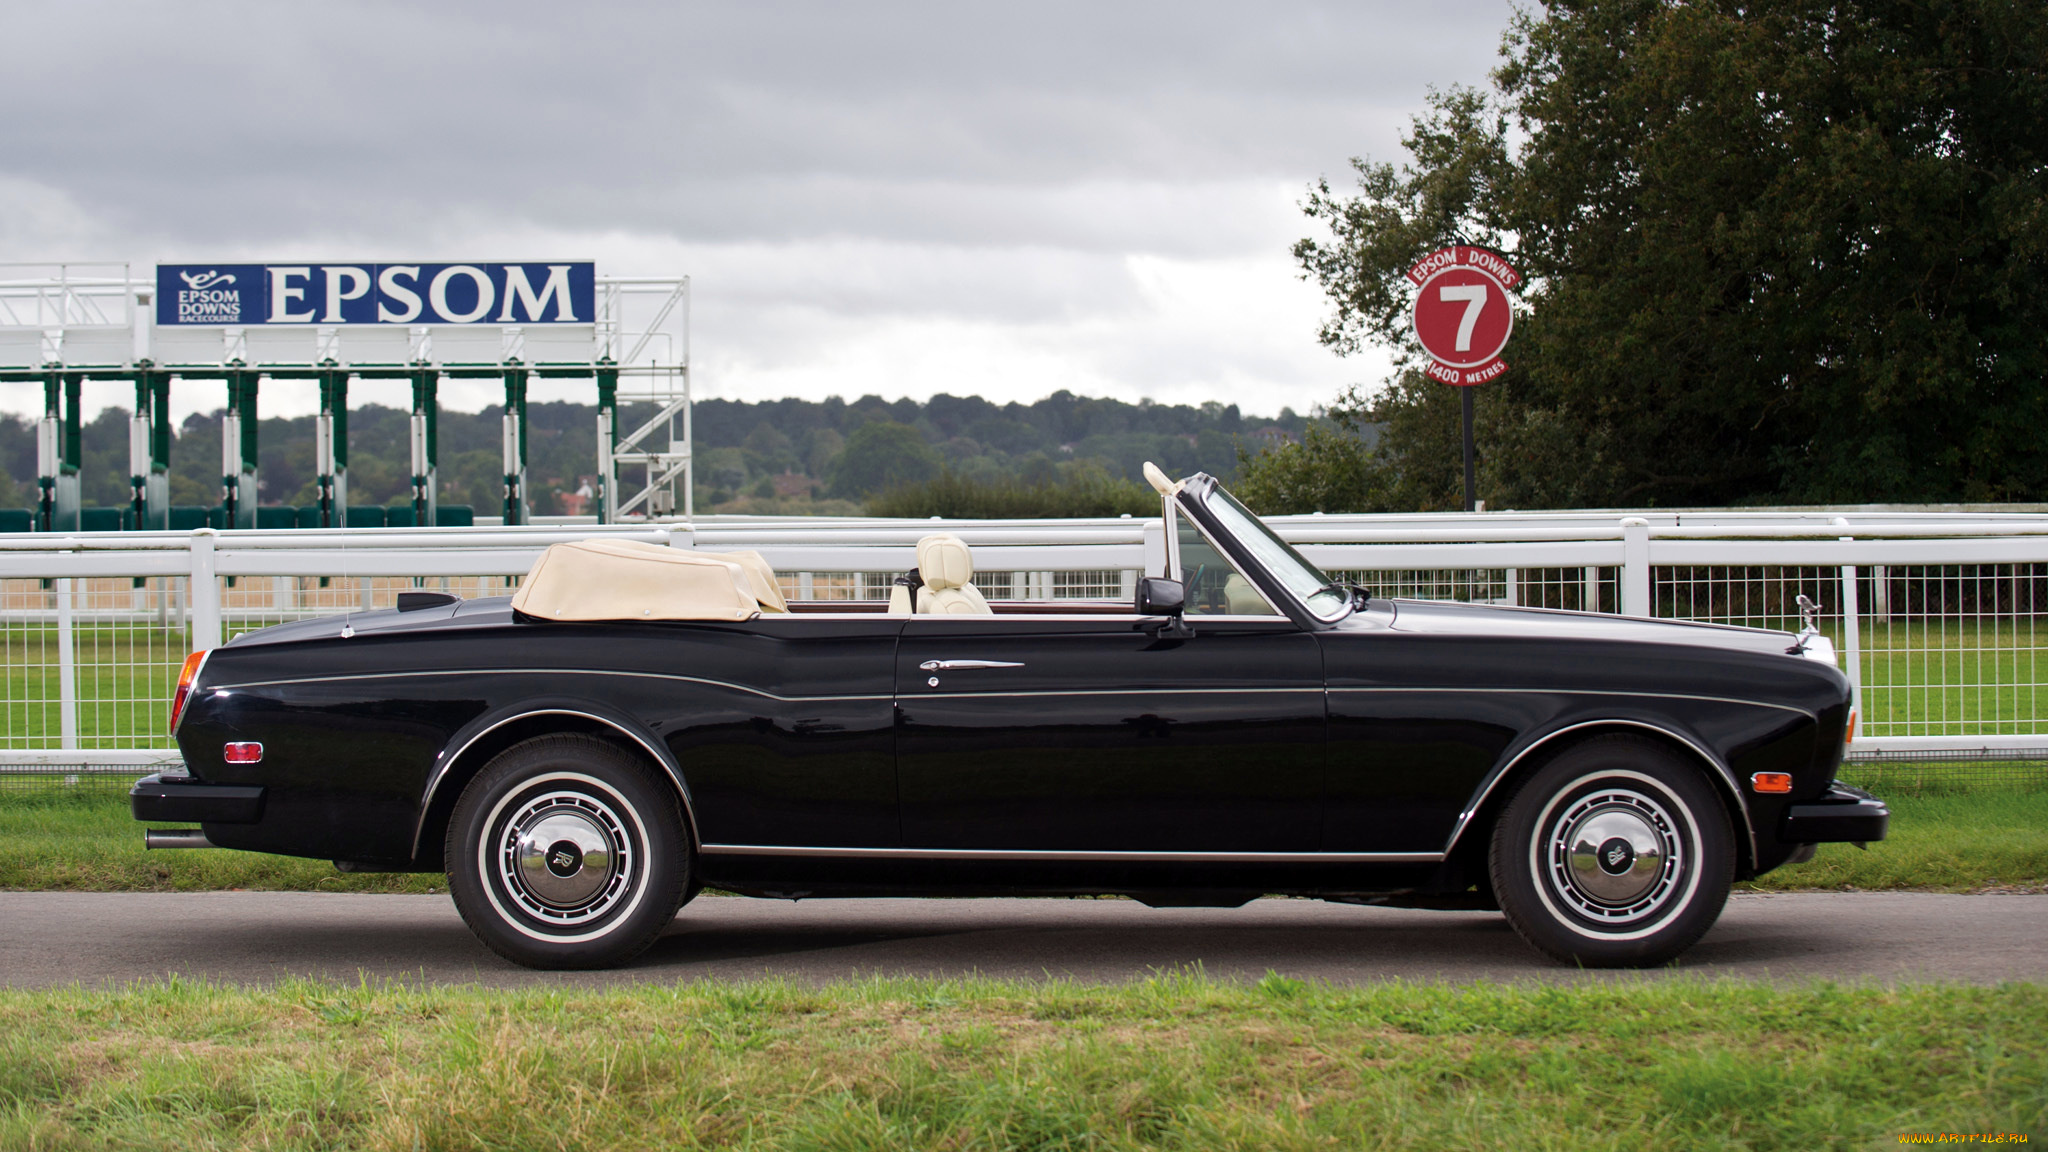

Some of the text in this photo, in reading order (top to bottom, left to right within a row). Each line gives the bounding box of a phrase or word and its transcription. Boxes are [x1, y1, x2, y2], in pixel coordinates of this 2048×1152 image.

[1412, 249, 1516, 285] EPSOM DOWNS
[179, 290, 240, 303] EPSOM
[179, 303, 241, 315] DOWNS
[266, 265, 579, 324] EPSOM
[1440, 285, 1487, 352] 7
[1429, 361, 1505, 384] 1400 METRES
